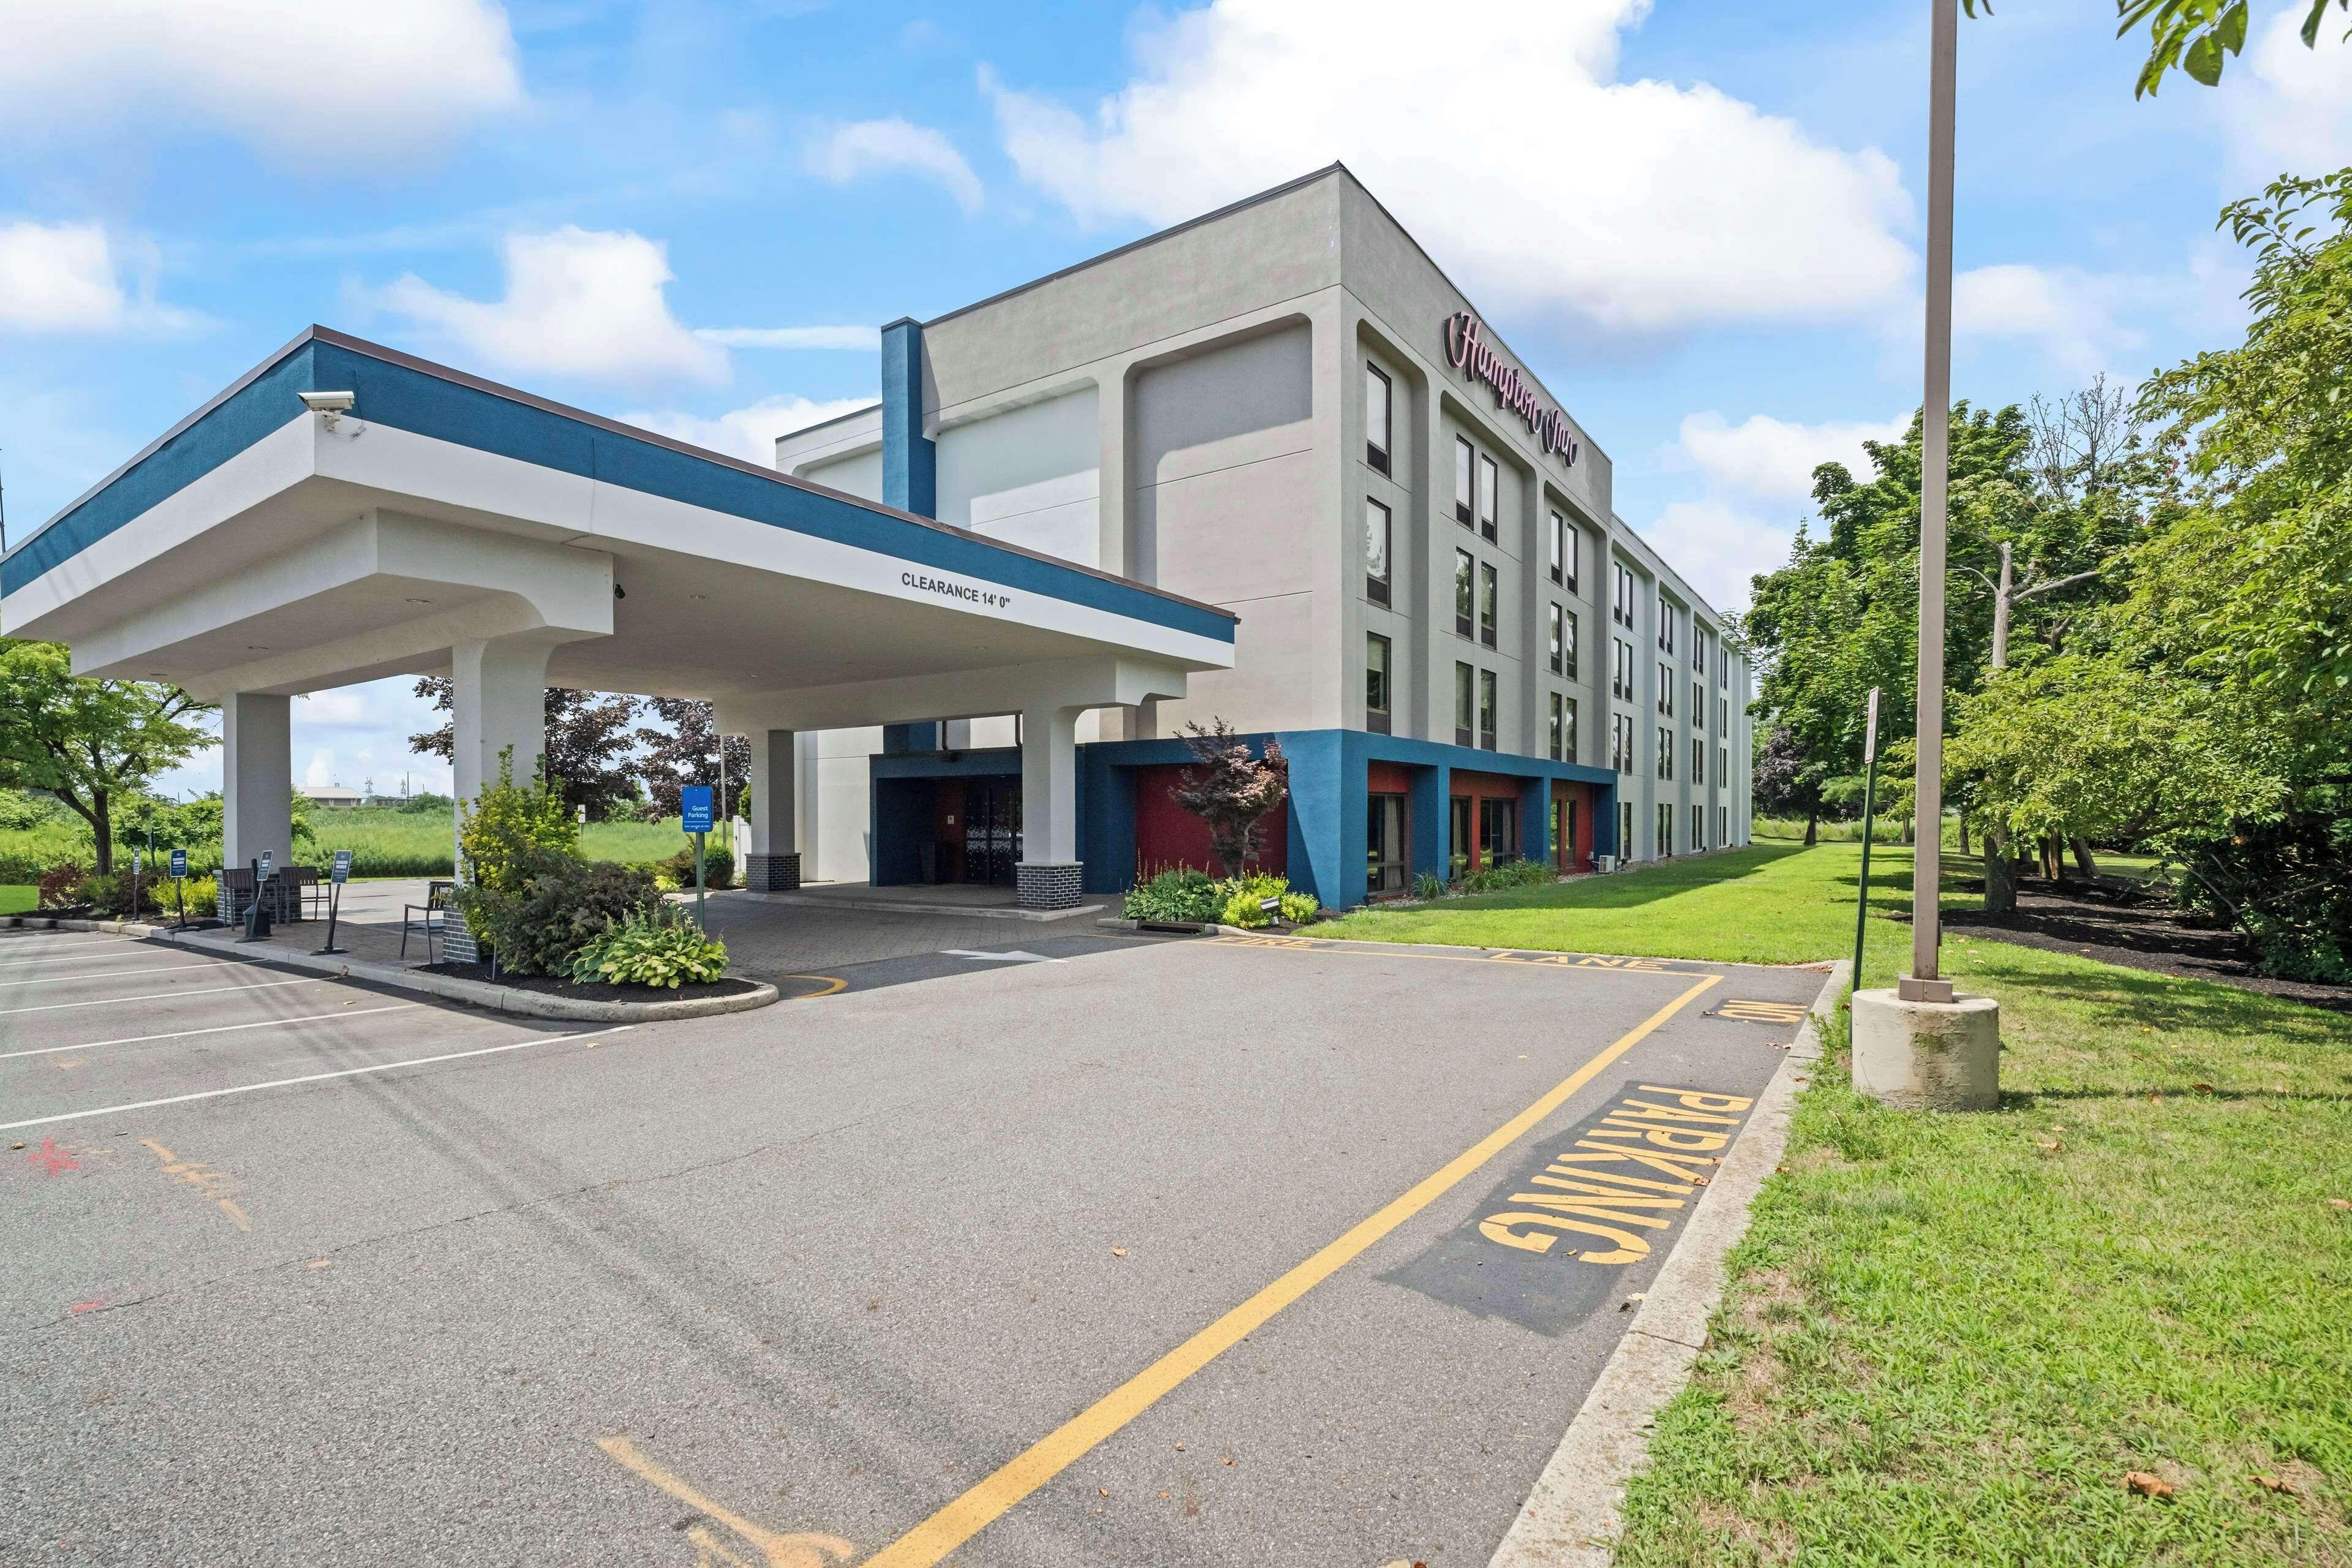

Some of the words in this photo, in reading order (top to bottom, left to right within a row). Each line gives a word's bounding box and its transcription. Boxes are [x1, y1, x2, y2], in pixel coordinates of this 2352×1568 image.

[1443, 311, 1542, 434] Hampton
[1542, 409, 1577, 467] Inn
[902, 572, 979, 602] CLEARANCE
[982, 592, 997, 606] 14'
[999, 596, 1010, 608] 0"
[1205, 937, 1328, 948] FIRE
[1490, 952, 1671, 970] LANE
[1717, 1000, 1808, 1023] NO
[1479, 1084, 1754, 1265] PARKING
